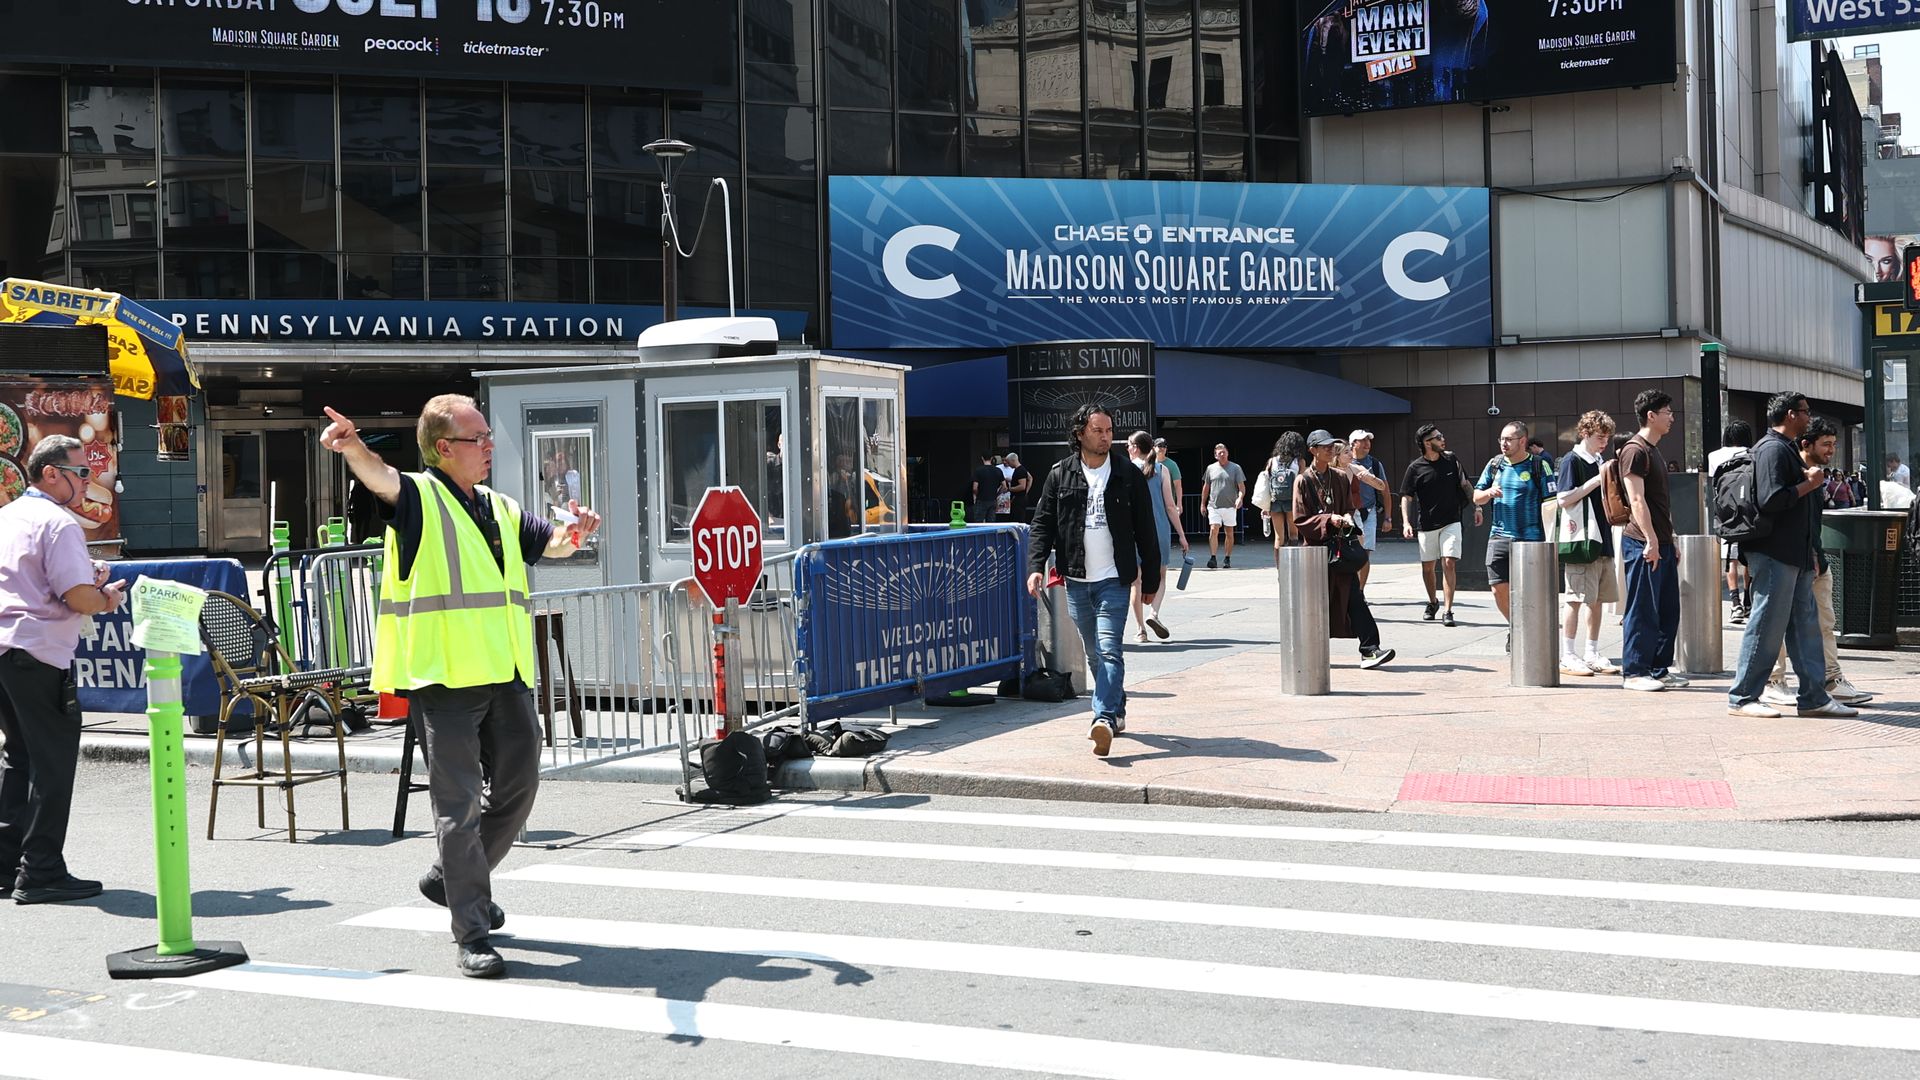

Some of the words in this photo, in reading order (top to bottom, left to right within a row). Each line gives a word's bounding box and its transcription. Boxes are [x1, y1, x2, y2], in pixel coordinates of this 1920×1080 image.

[1357, 1, 1423, 32] MAIN
[1806, 0, 1885, 24] West
[212, 27, 257, 43] MADISON
[260, 29, 298, 46] SQUARE
[301, 31, 339, 48] GARDEN
[364, 36, 433, 53] peacock
[463, 41, 545, 57] ticketmaster
[1357, 27, 1424, 55] EVENT
[1538, 36, 1573, 50] MADISON
[1574, 32, 1603, 46] SQUARE
[1605, 29, 1636, 43] GARDEN
[1560, 57, 1611, 69] ticketmaster
[1054, 224, 1130, 242] CHASE
[1162, 226, 1295, 244] ENTRANCE
[882, 224, 962, 300] C
[1006, 249, 1125, 290] MADISON
[1134, 249, 1231, 294] SQUARE
[1240, 251, 1334, 292] GARDEN
[1382, 231, 1451, 301] C
[1058, 296, 1083, 304] THE
[1088, 296, 1146, 304] WORLD'S
[1151, 297, 1187, 305] MOST
[1192, 297, 1242, 305] FAMOUS
[1247, 297, 1288, 305] ARENA
[171, 313, 461, 337] PENNSYLVANIA
[481, 316, 623, 337] STATION
[1078, 347, 1141, 369] STATION
[1024, 411, 1067, 430] MADISON
[1115, 409, 1147, 428] GARDEN
[697, 525, 758, 573] STOP
[149, 586, 194, 605] PARKING
[881, 619, 954, 649] WELCOME
[958, 616, 973, 636] TO
[855, 654, 901, 688] THE
[906, 637, 998, 680] GARDEN
